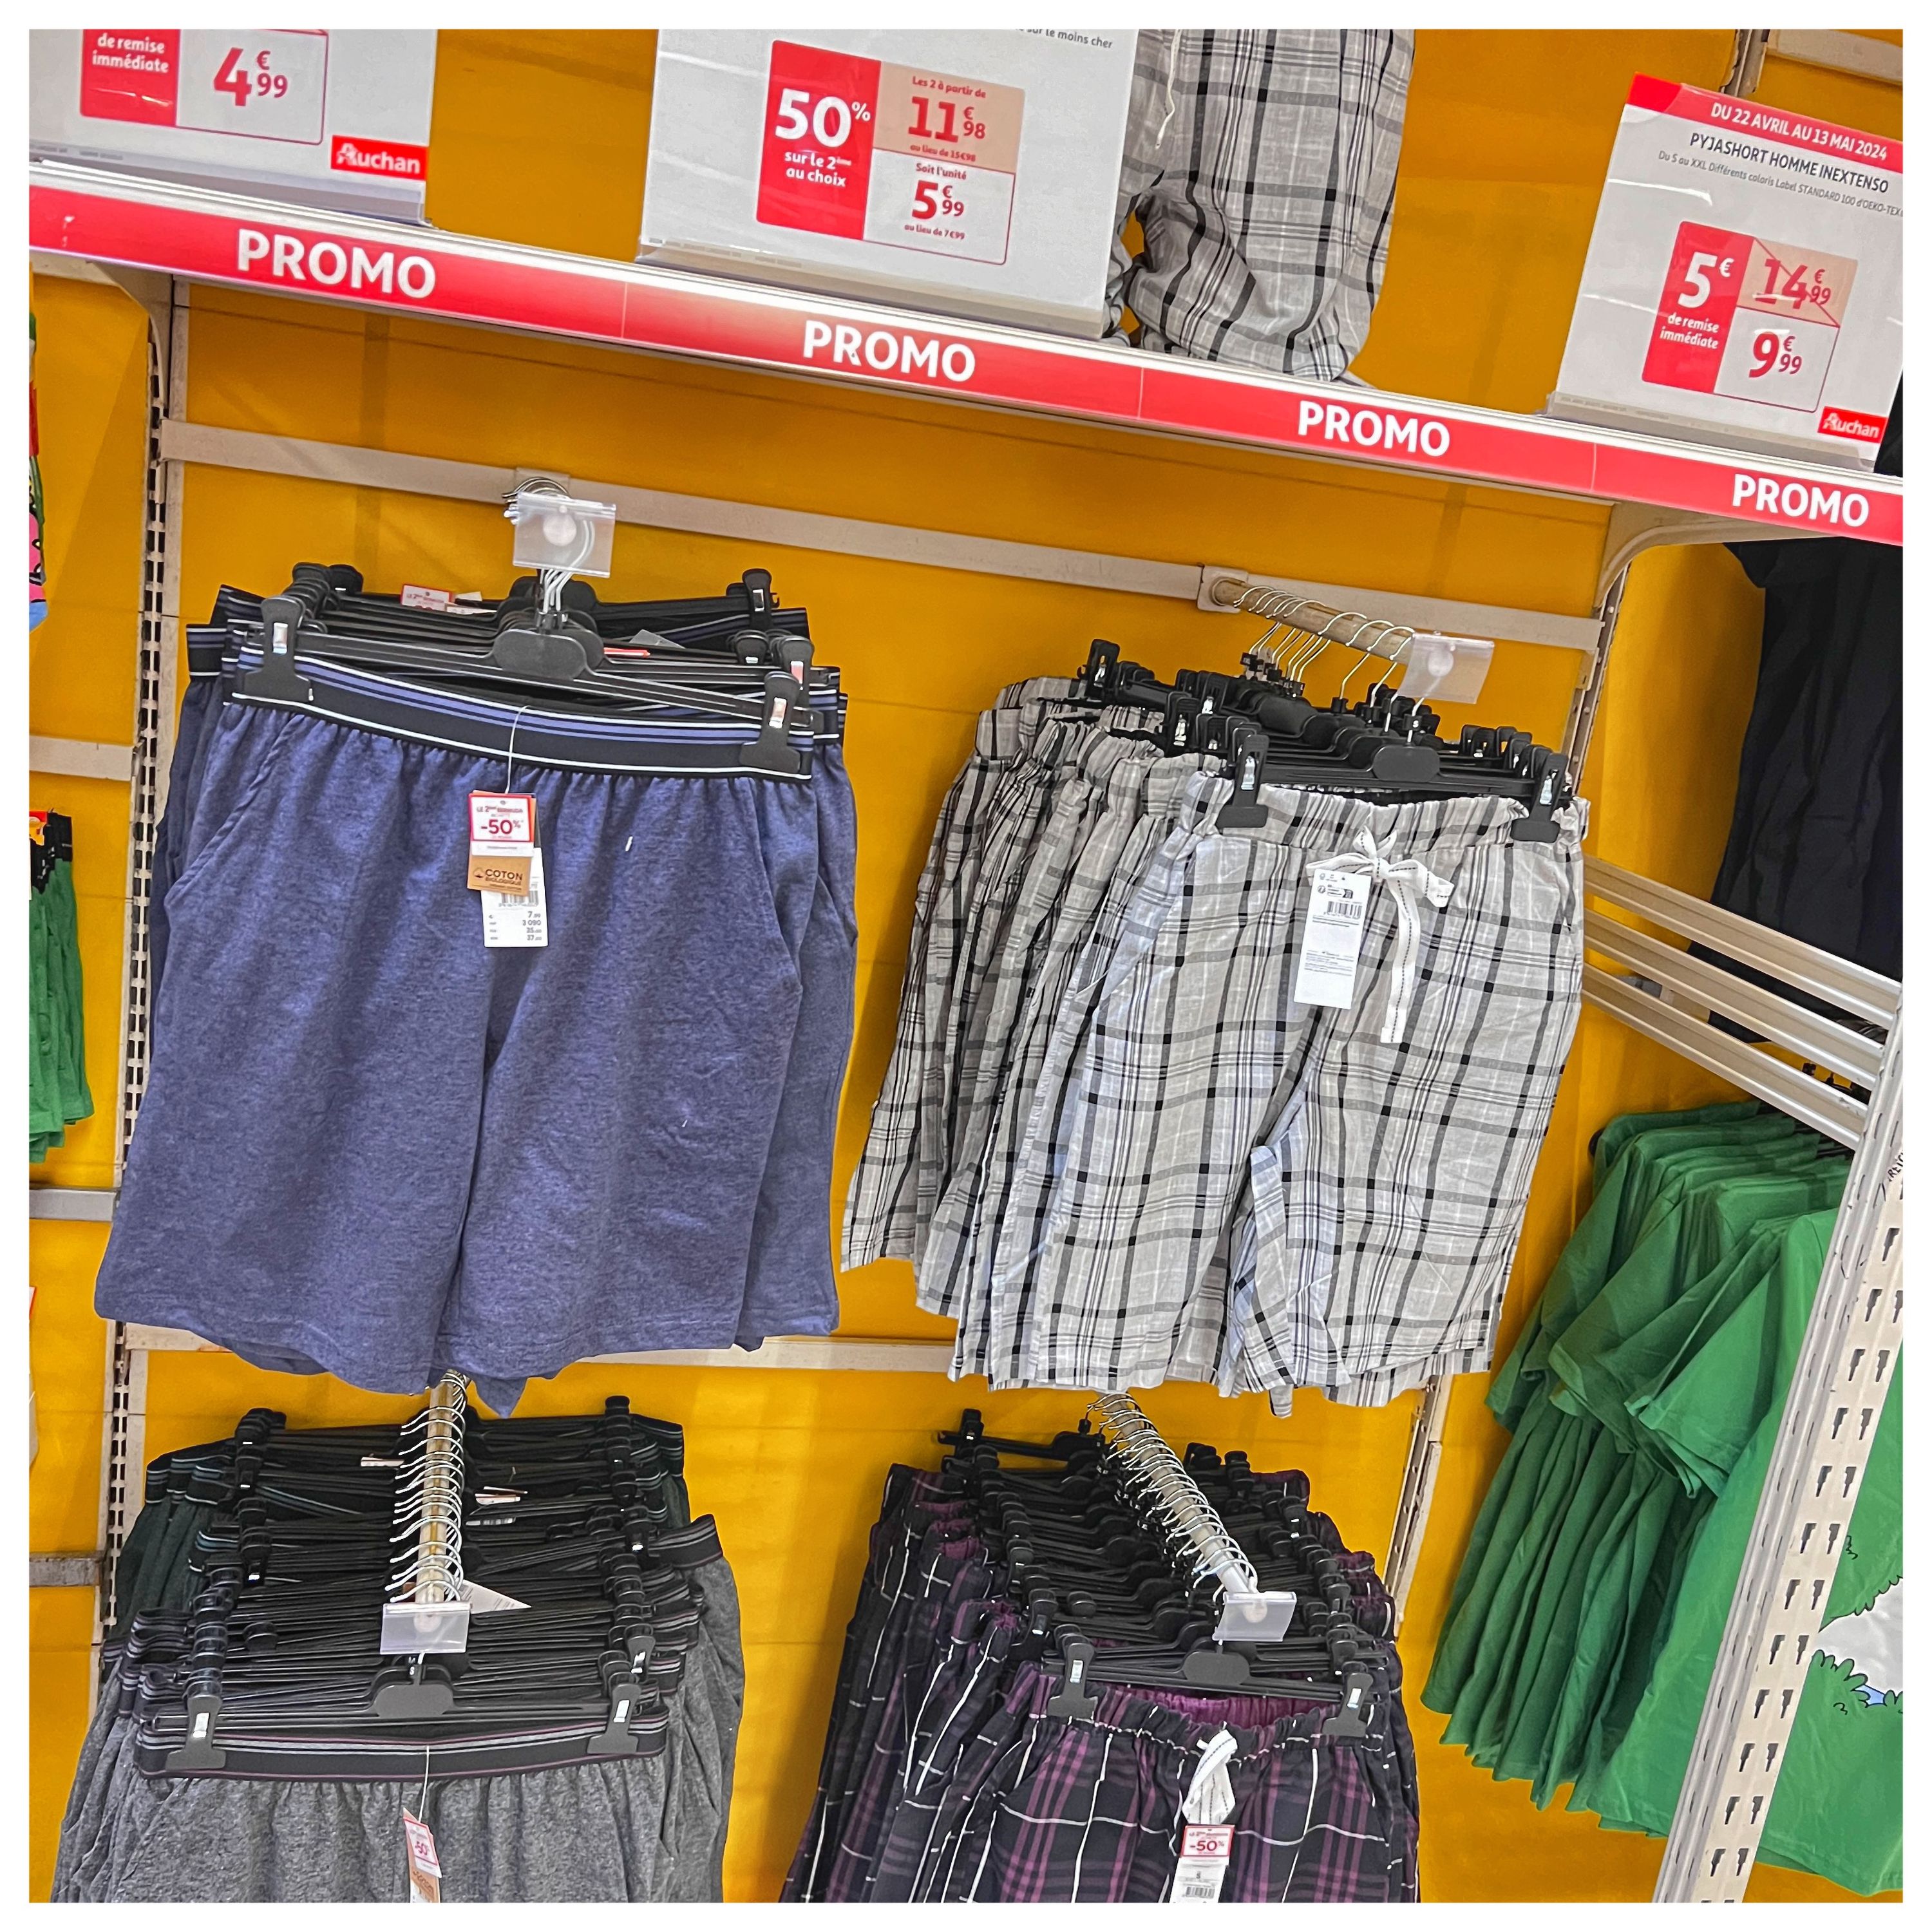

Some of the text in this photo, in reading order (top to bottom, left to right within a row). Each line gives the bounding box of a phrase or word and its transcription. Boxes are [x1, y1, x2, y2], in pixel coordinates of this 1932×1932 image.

[97, 32, 165, 53] de remise
[1057, 32, 1089, 44] moins
[1091, 37, 1113, 49] cher
[92, 49, 169, 73] immédiate
[913, 76, 987, 98] Les 2 à partir de
[775, 88, 871, 147] 50%
[1710, 102, 1888, 161] DU 22 AVRIL AU 13 MAI 2024
[336, 142, 421, 174] Auchan
[784, 151, 808, 164] sur
[810, 153, 824, 167] le
[939, 148, 949, 157] de
[1689, 132, 1889, 194] PYJASHORT HOMME INEXTENSO
[786, 167, 847, 187] au choix
[916, 163, 967, 180] Soit l'unité
[1658, 150, 1670, 161] Du
[1690, 158, 1707, 170] XXL
[1709, 162, 1747, 180] Différents
[1748, 173, 1774, 186] coloris
[1775, 178, 1797, 191] Label
[1797, 183, 1841, 202] STANDARD
[1841, 194, 1856, 205] 100
[237, 228, 435, 298] PROMO
[1667, 312, 1719, 334] de remise
[1659, 326, 1719, 349] immédiate
[803, 320, 976, 383] PROMO
[1298, 400, 1450, 457] PROMO
[1822, 412, 1879, 439] Auchan
[1732, 473, 1870, 527] PROMO
[485, 868, 523, 881] COTON
